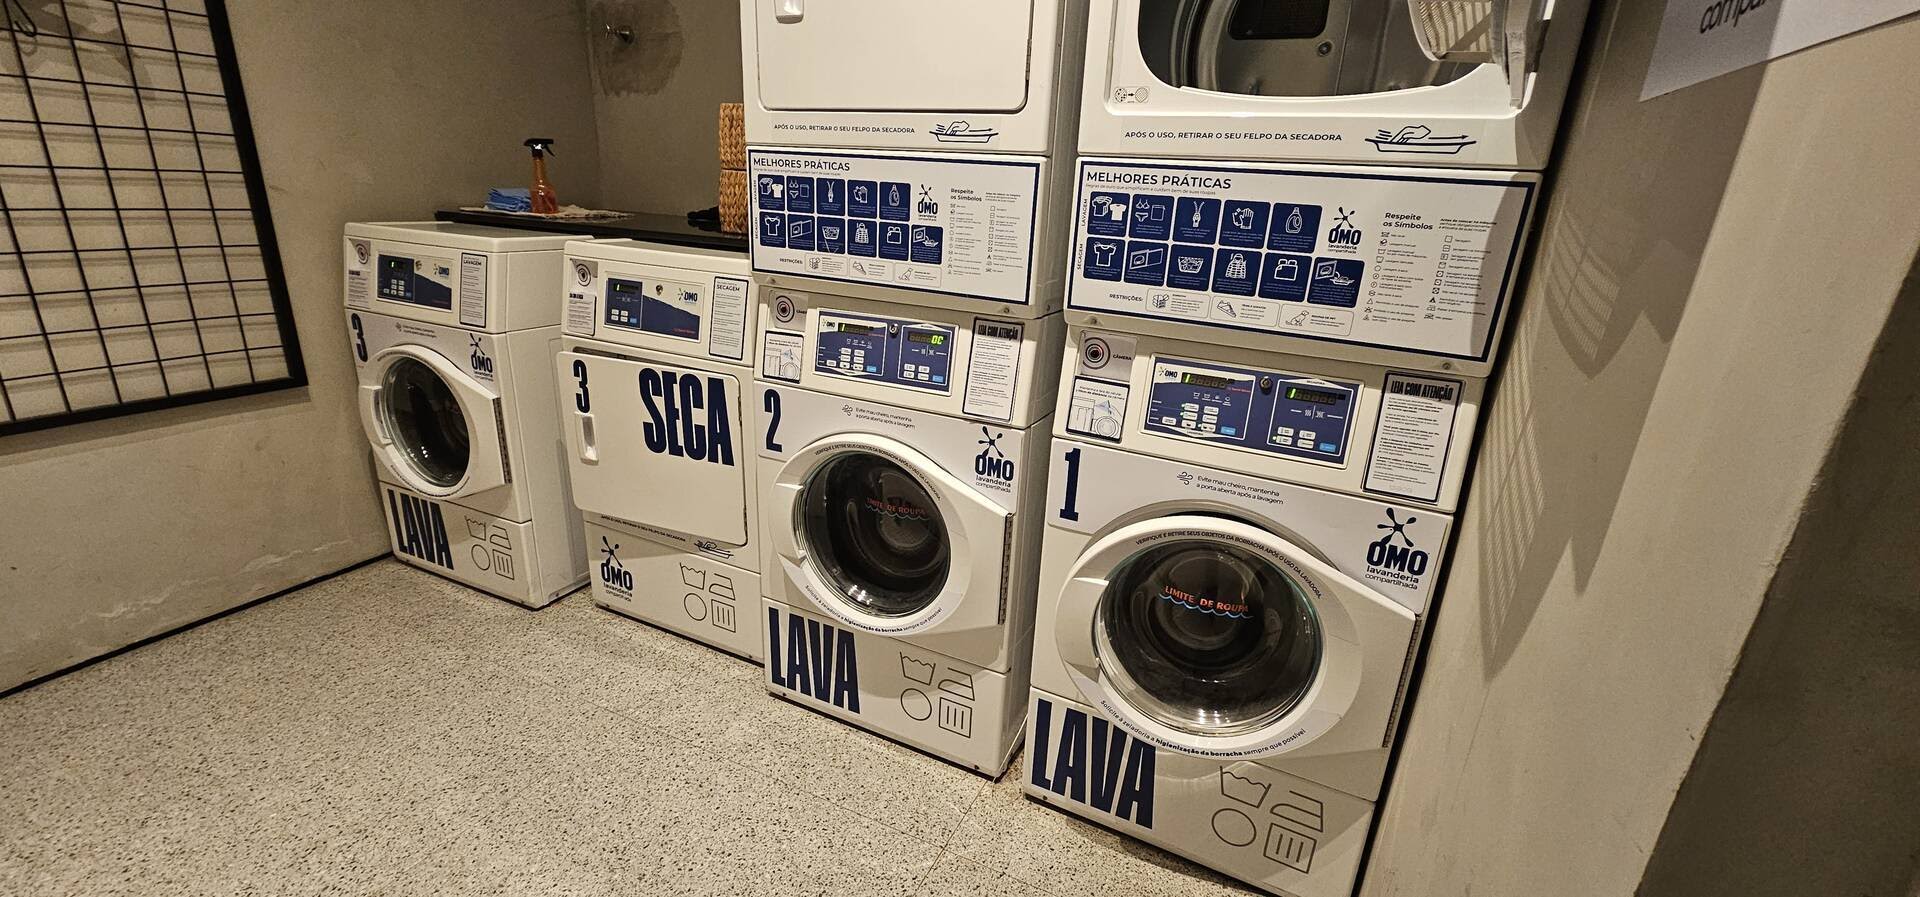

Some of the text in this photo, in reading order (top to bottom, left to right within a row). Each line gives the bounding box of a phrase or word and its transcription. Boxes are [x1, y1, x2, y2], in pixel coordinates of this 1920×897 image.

[1701, 0, 1766, 34] comp
[1125, 131, 1146, 139] APÓS
[1157, 132, 1176, 140] USO,
[754, 158, 850, 171] MELHORES PRÁTICAS
[1087, 172, 1232, 189] MELHORES PRÁTICAS
[918, 201, 938, 215] OMO
[1385, 212, 1421, 221] Respeite
[1394, 221, 1433, 230] Símbolos
[1328, 228, 1362, 245] OMO
[684, 292, 698, 302] OMO
[1109, 294, 1143, 302] RESTRIÇÕES:
[351, 313, 368, 362] 3
[471, 354, 493, 373] OMO
[1165, 370, 1177, 378] OMO
[573, 360, 590, 413] 3
[1290, 388, 1296, 398] 1
[1391, 380, 1454, 402] LEIA COM ATENÇÃO
[639, 368, 734, 466] SECA
[764, 388, 782, 452] 2
[974, 454, 1014, 482] OMO
[975, 482, 1011, 494] compartilhada
[976, 476, 1011, 488] lavanderia
[1059, 448, 1081, 522] 1
[1213, 478, 1226, 486] mau
[1228, 480, 1246, 490] cheiro,
[1247, 485, 1280, 496] mantenha
[1201, 484, 1216, 492] porta
[1217, 486, 1236, 496] aberta
[1237, 490, 1251, 500] após
[1257, 493, 1283, 505] lavagem
[387, 489, 454, 570] LAVA
[1136, 534, 1162, 545] VERIFIQUE
[1235, 537, 1264, 551] BORRACHA
[1264, 548, 1279, 558] APÓS
[1284, 558, 1294, 568] USO
[1293, 566, 1301, 574] DA
[1300, 572, 1321, 598] LAVADORA
[1366, 540, 1428, 576] OMO
[601, 563, 633, 590] OMO
[1365, 574, 1418, 590] compartilhada
[1366, 565, 1419, 583] lavanderia
[604, 582, 632, 597] lavanderia
[1165, 585, 1249, 613] LIMITE DE ROUPA
[768, 607, 860, 714] LAVA
[1100, 700, 1119, 719] Solicite
[1123, 721, 1150, 739] zeladoria
[1156, 739, 1199, 755] higienização
[1244, 746, 1268, 755] sempre
[1270, 741, 1282, 750] que
[1282, 728, 1306, 746] possível
[1031, 698, 1157, 830] LAVA
